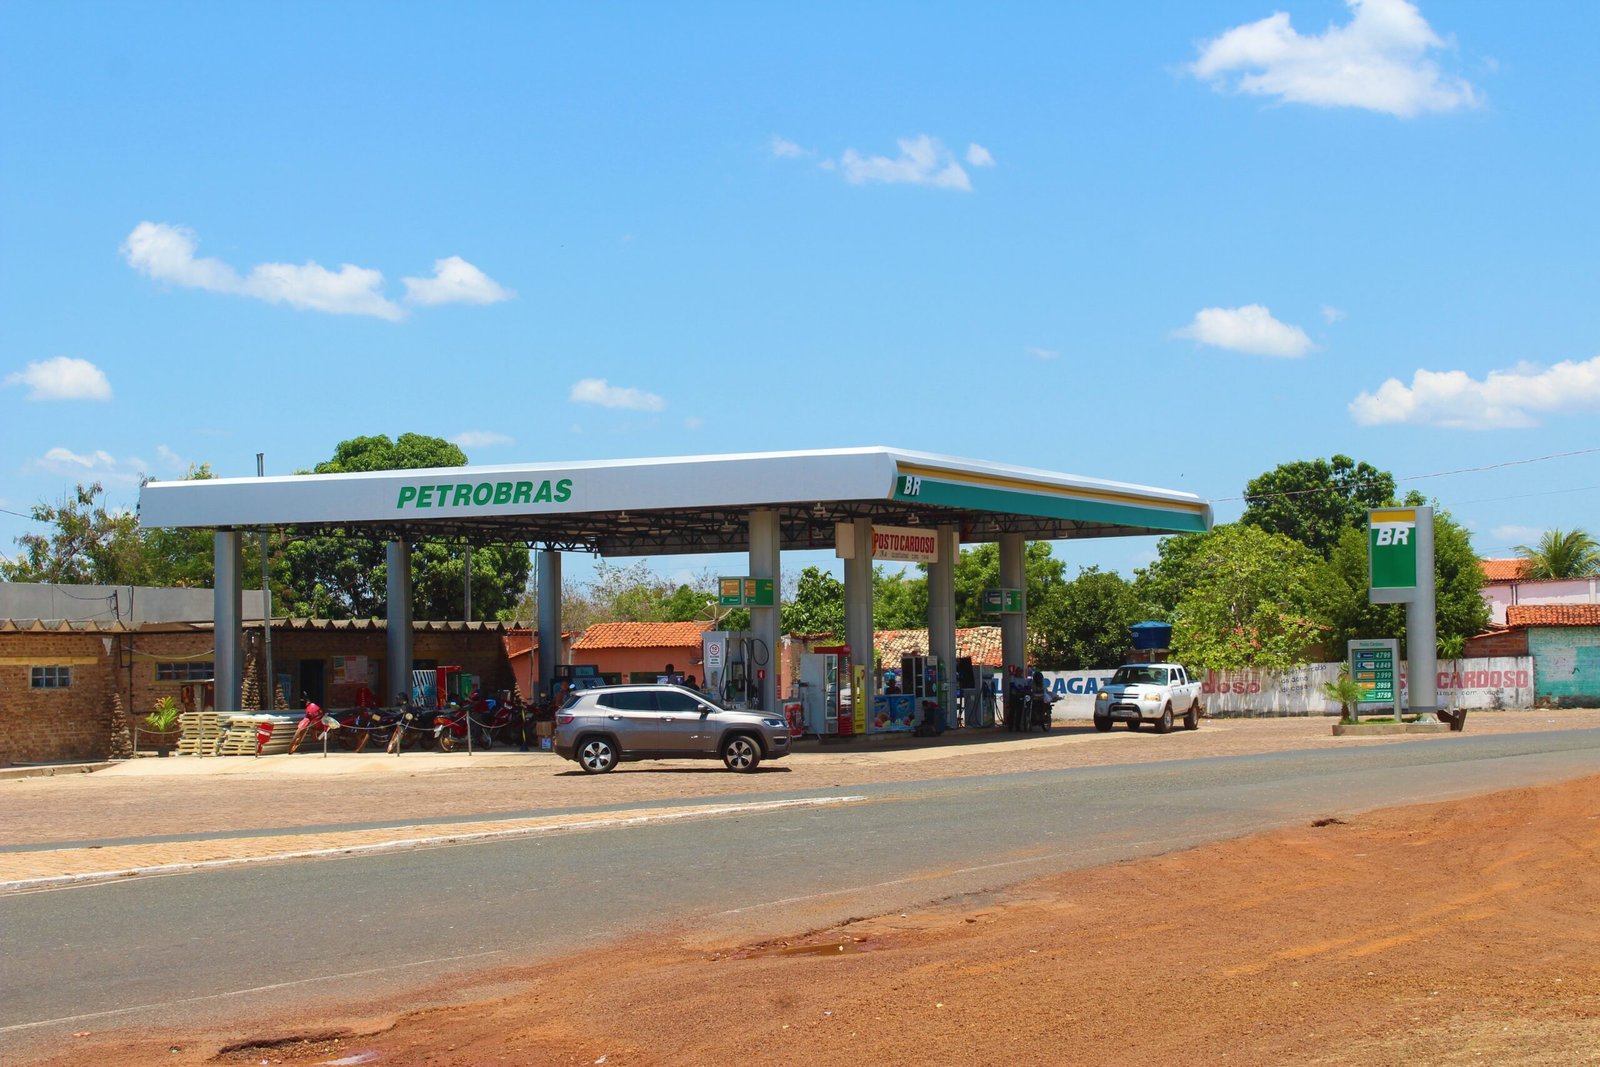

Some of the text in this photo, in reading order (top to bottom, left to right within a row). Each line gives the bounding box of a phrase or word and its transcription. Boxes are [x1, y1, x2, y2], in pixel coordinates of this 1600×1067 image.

[397, 479, 573, 509] PETROBRAS
[904, 476, 921, 495] BR
[874, 533, 935, 554] POSTO CARDOSO
[1376, 526, 1409, 546] BR
[1201, 669, 1260, 694] doso
[1437, 671, 1529, 690] CARDOSO
